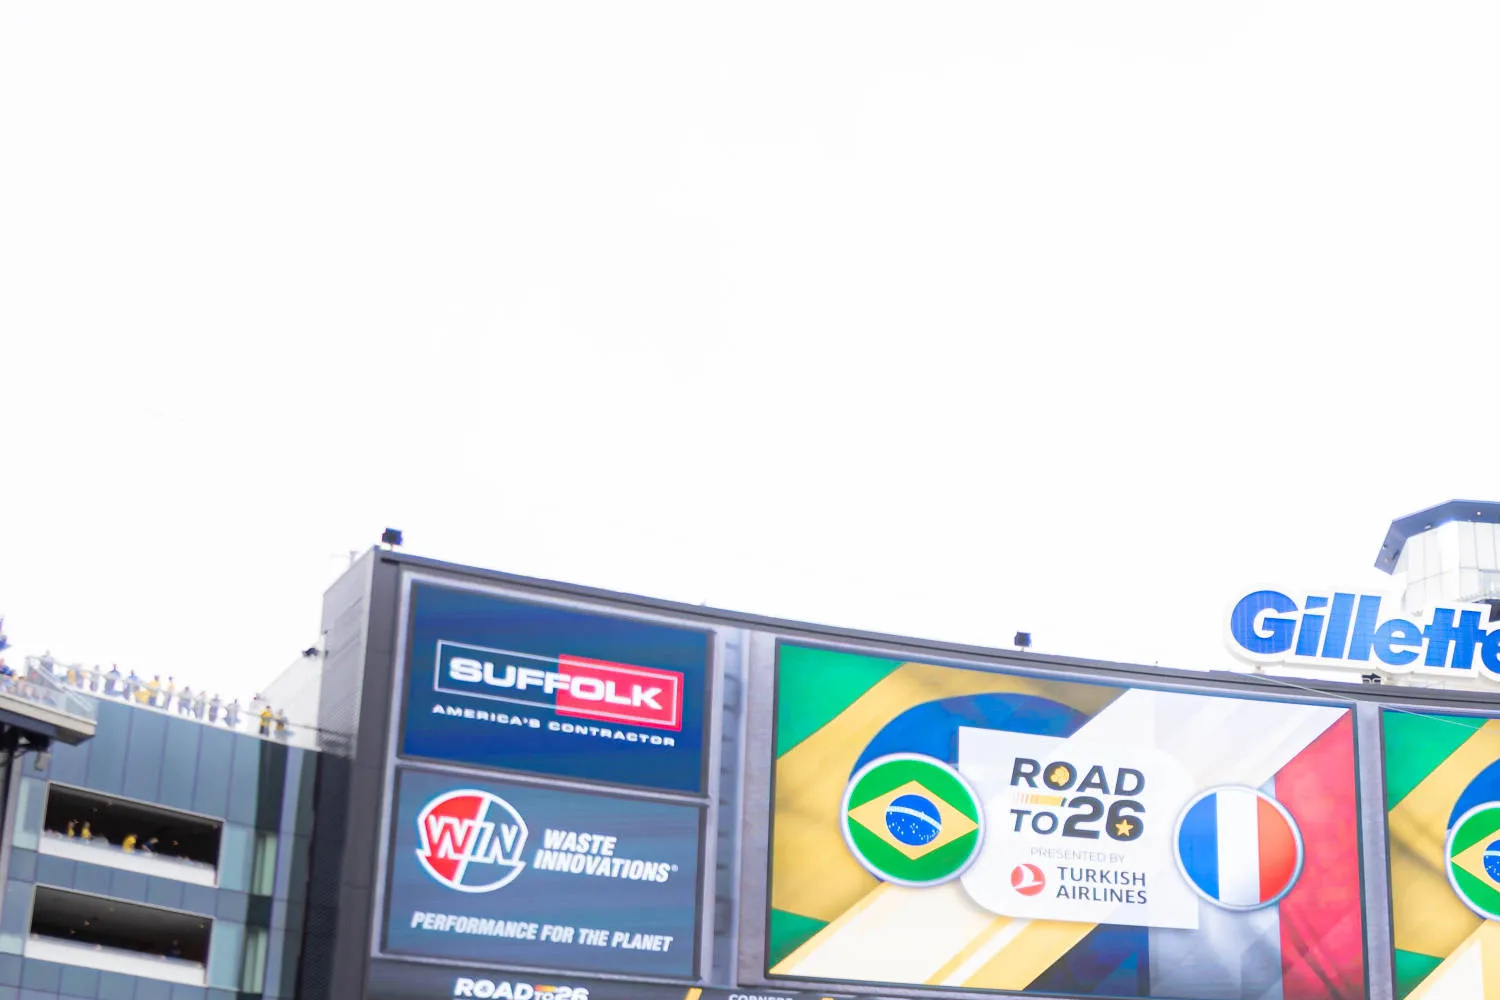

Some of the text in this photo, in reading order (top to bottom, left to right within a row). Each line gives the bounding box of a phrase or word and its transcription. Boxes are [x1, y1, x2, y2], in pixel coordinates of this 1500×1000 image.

[449, 656, 663, 711] SUFFOLK
[432, 704, 676, 747] AMERICA'S CONTRACTOR
[1009, 757, 1146, 796] ROAD
[1010, 809, 1060, 834] TO
[427, 813, 519, 864] WIN
[543, 829, 617, 856] WASTE
[1030, 847, 1126, 864] PRESENTED BY
[1057, 866, 1147, 887] TURKISH
[1056, 884, 1148, 905] AIRLINES
[410, 911, 674, 952] PERFORMANCE FOR THE PLANET
